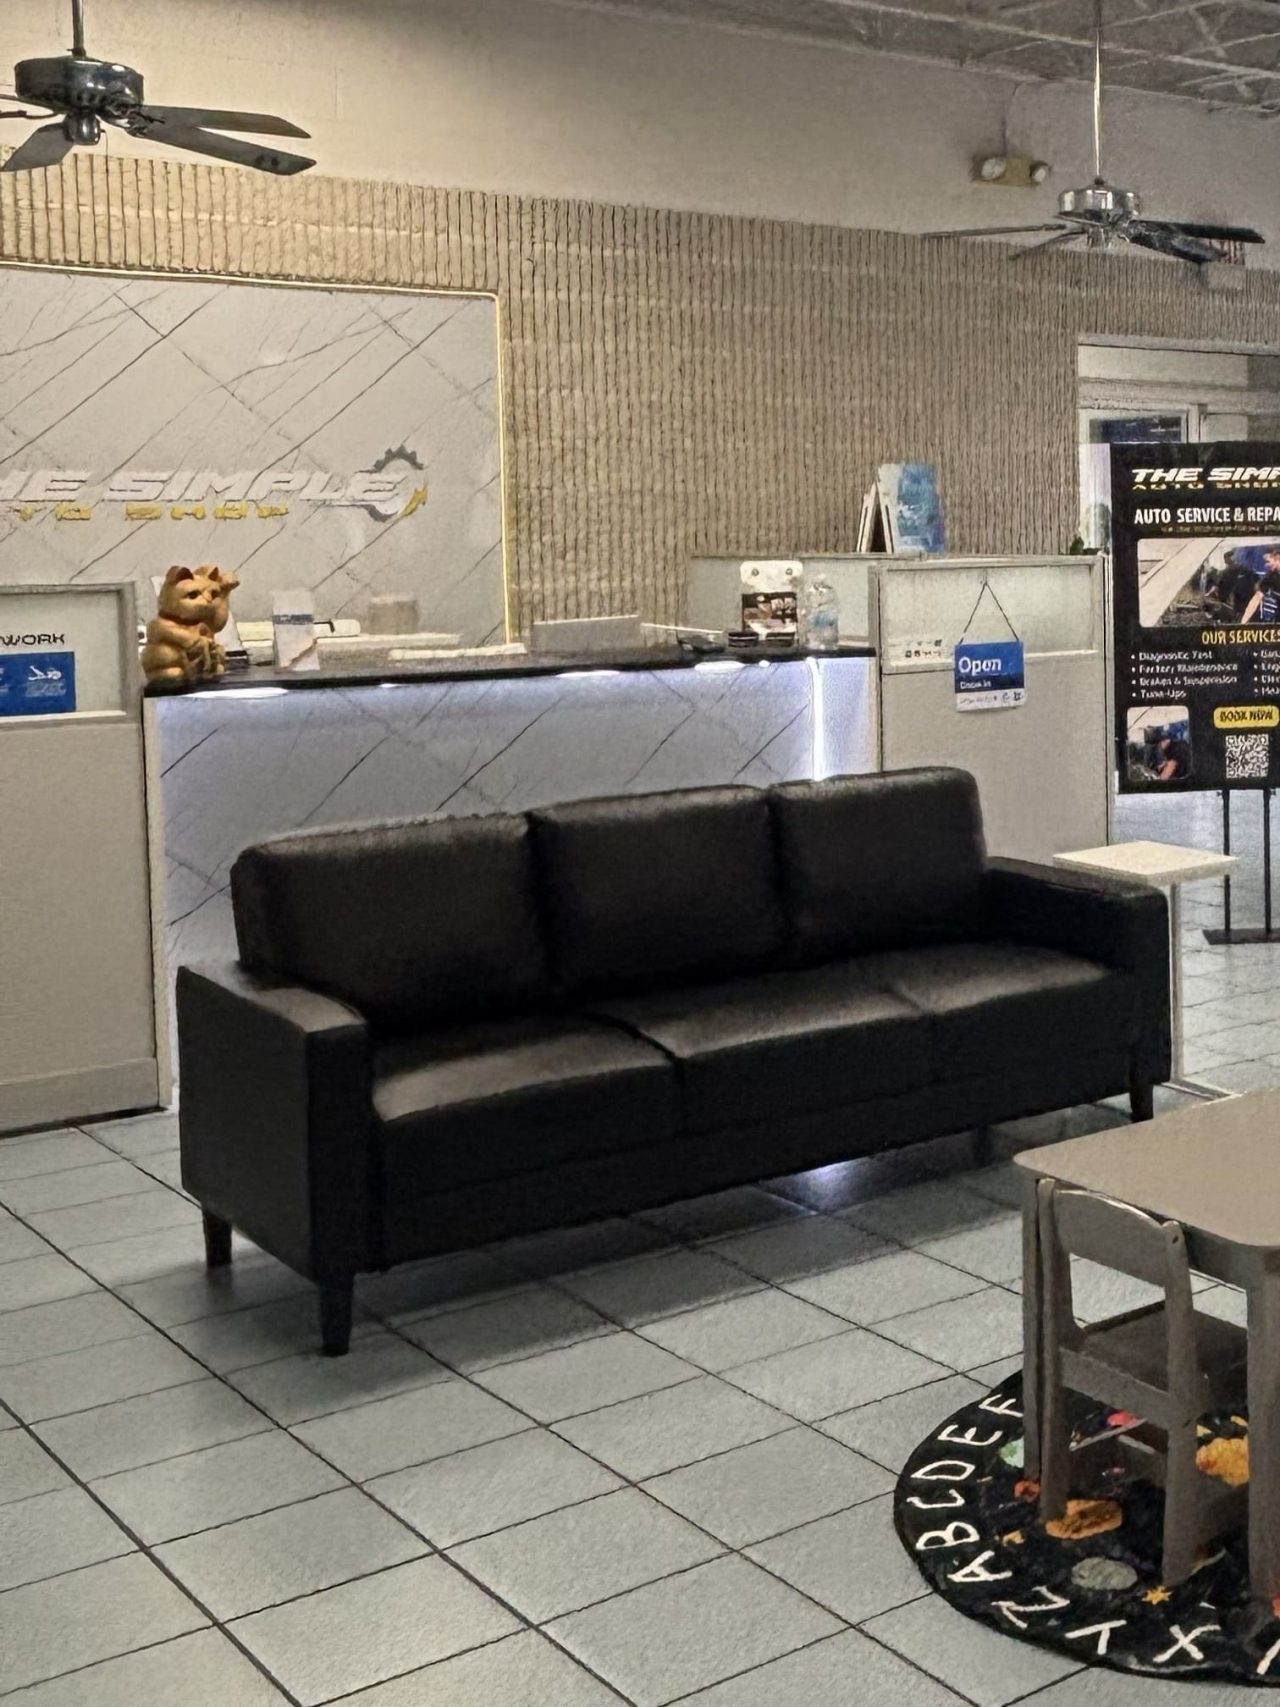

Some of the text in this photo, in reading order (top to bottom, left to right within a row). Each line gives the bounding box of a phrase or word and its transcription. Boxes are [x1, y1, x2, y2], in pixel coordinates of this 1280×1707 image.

[1132, 467, 1203, 482] THE
[104, 468, 407, 502] SIMPLE
[1134, 508, 1171, 524] AUTO
[1177, 506, 1231, 523] SERVICE
[1234, 506, 1244, 521] &
[1201, 629, 1227, 645] OUR
[958, 656, 1002, 676] Open
[1219, 710, 1274, 722] BOOK NOW
[937, 1424, 1003, 1446] E
[910, 1460, 975, 1481] D
[906, 1488, 965, 1509] C
[915, 1521, 980, 1550] B
